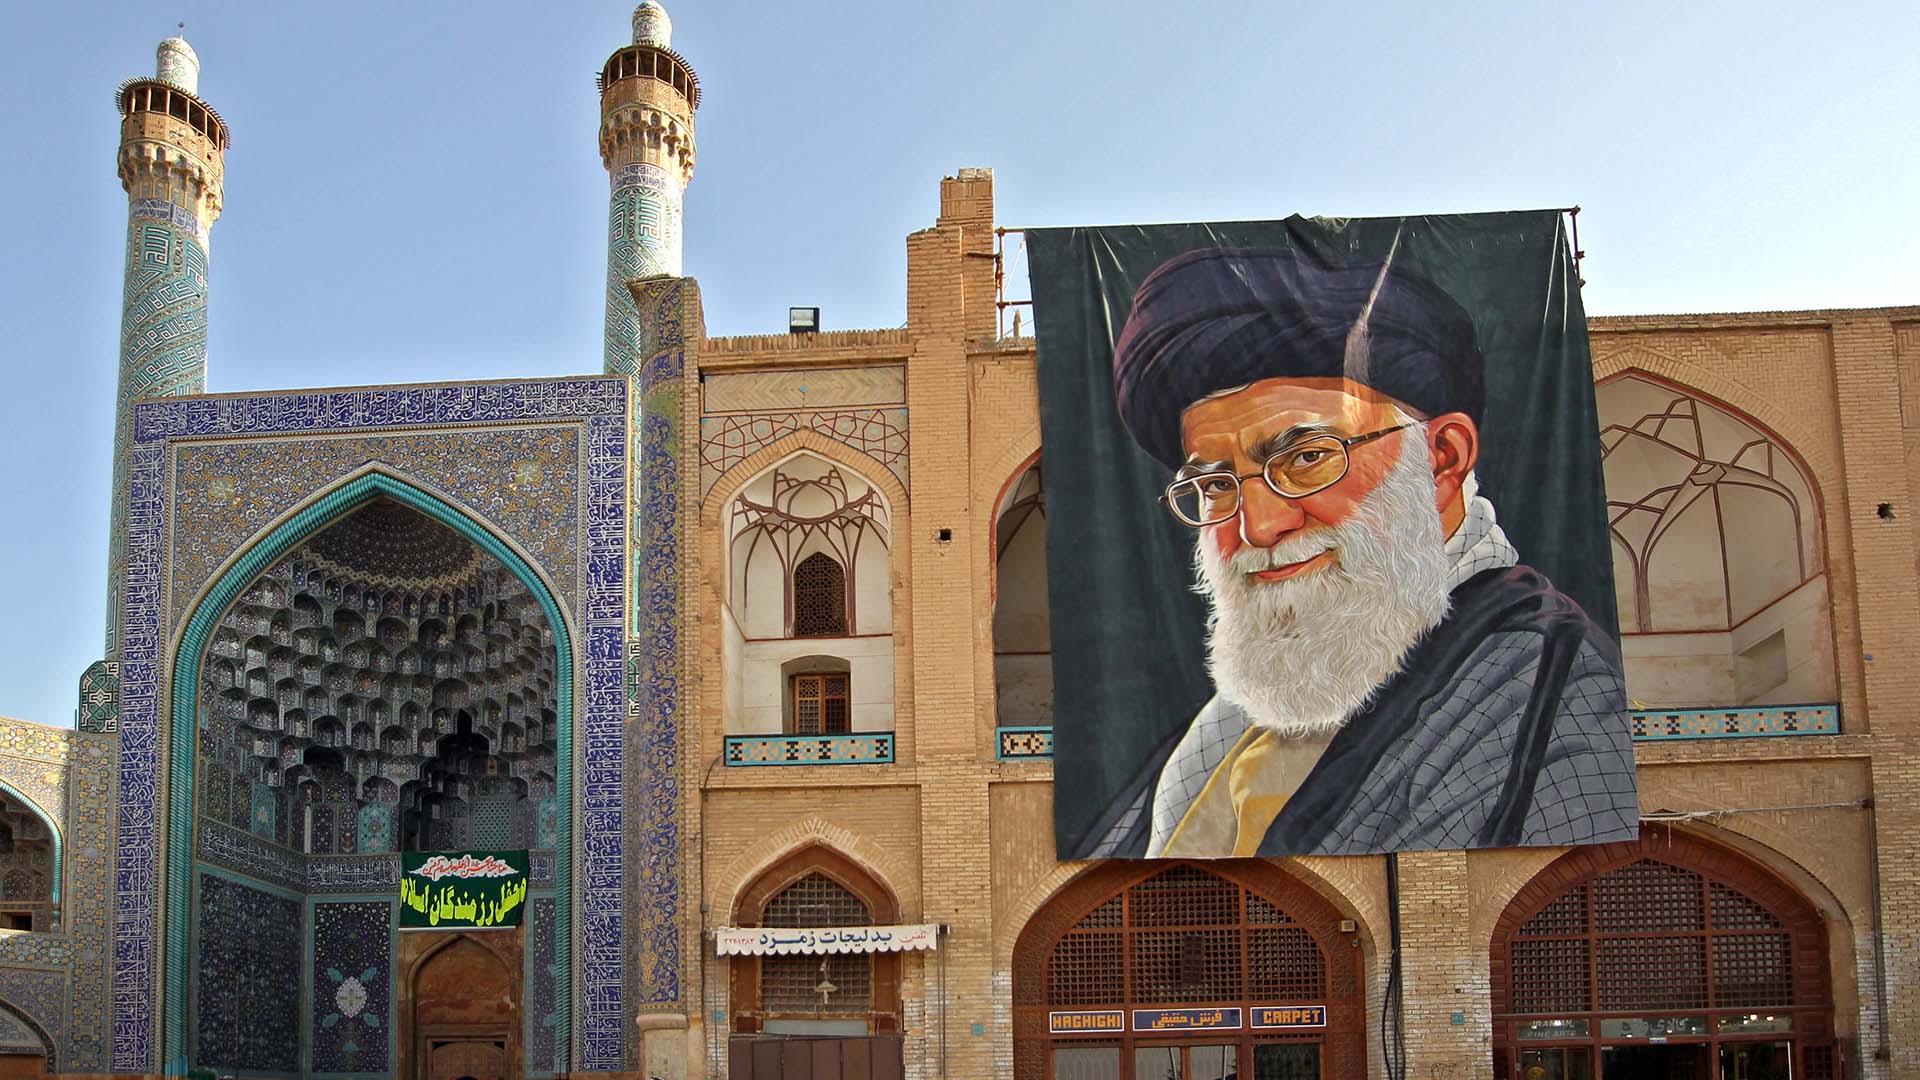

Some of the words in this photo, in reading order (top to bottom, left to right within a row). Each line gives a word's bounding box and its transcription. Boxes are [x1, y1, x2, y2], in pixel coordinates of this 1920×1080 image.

[429, 885, 494, 927] رزمندگان
[495, 877, 527, 923] محفل
[820, 929, 893, 947] بدلیجات
[1052, 1014, 1121, 1029] HAGHIGHI
[1152, 1012, 1188, 1029] حقیقی
[1190, 1009, 1222, 1026] فرش
[1263, 1010, 1321, 1024] CARPET
